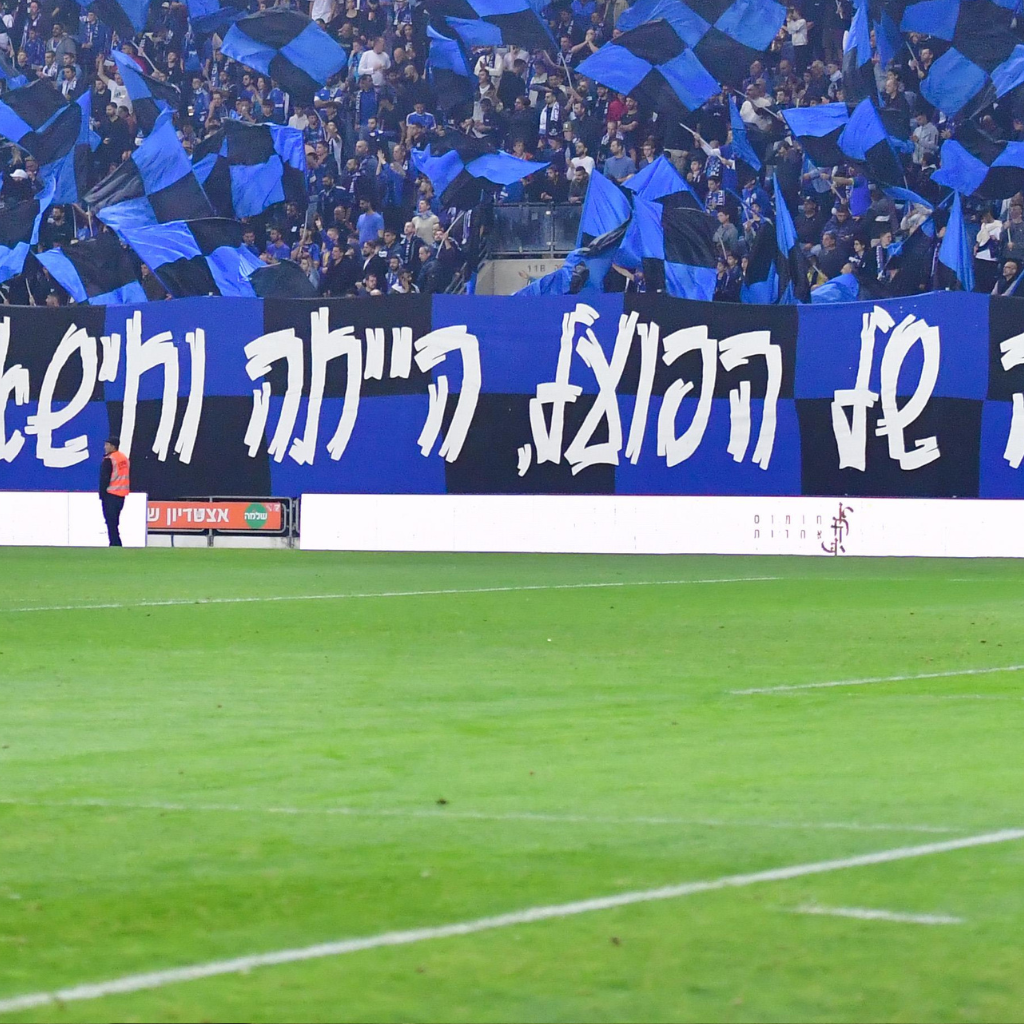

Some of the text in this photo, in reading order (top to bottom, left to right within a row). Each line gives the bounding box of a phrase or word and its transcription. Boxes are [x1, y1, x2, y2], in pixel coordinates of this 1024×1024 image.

[832, 306, 940, 471] של
[166, 508, 230, 525] אצטדיון
[244, 511, 268, 520] שלמה
